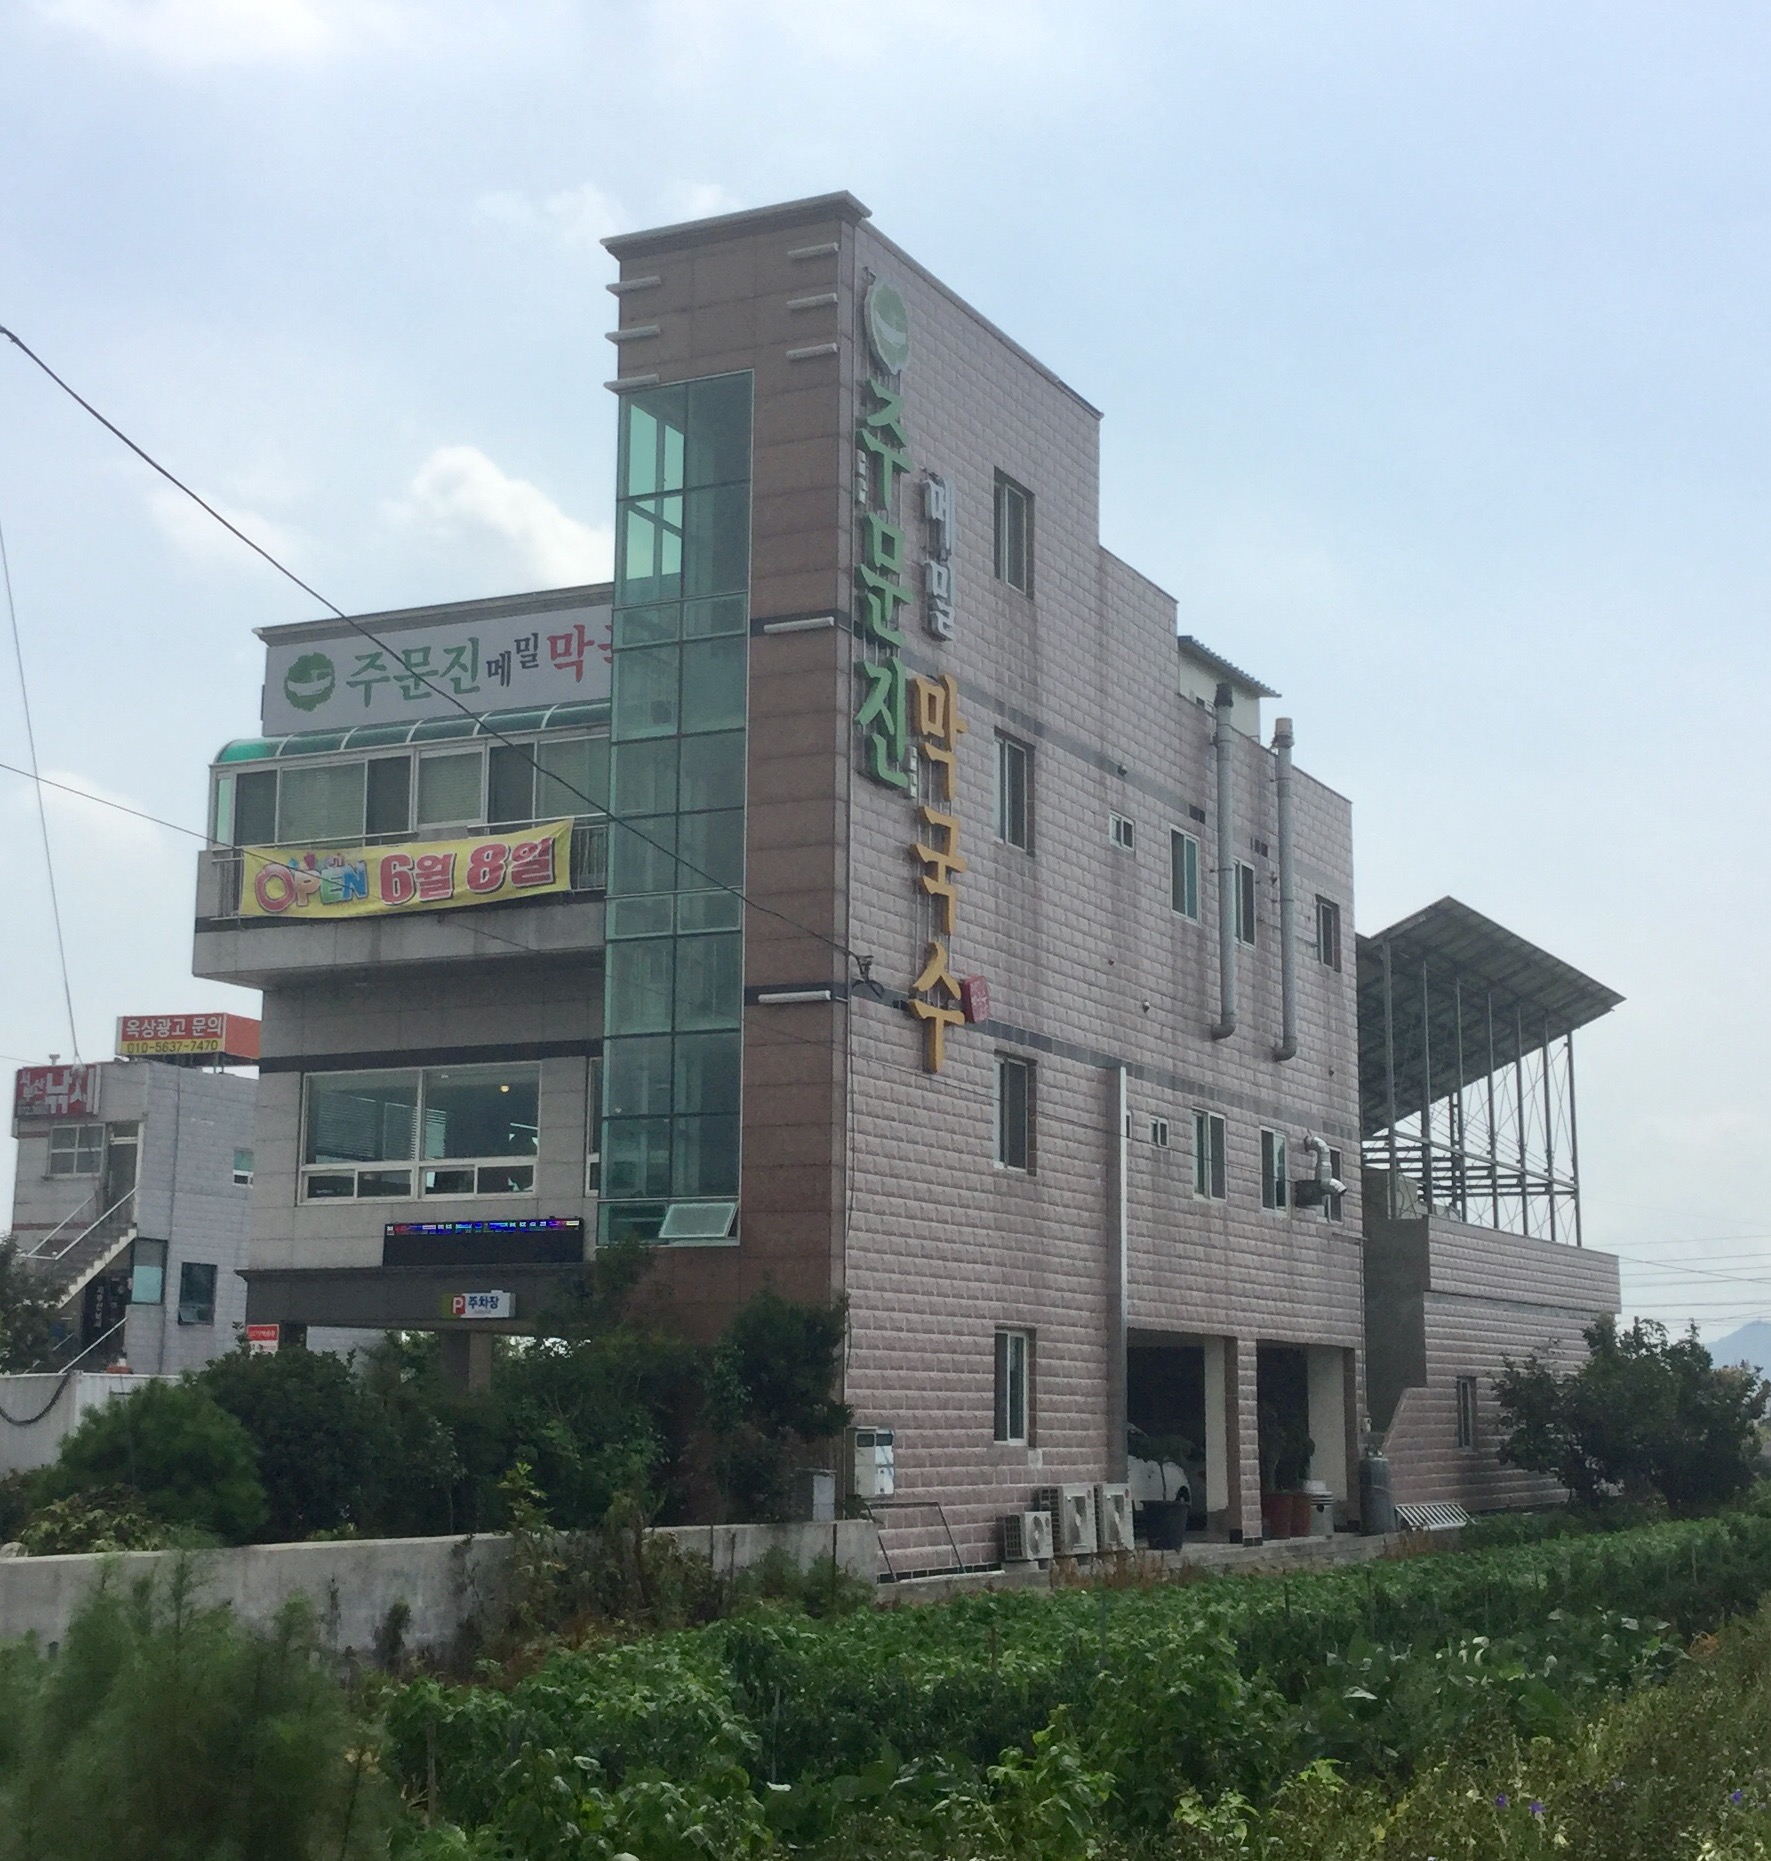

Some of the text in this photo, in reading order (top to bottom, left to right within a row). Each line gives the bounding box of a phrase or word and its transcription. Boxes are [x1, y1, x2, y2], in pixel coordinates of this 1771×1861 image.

[854, 377, 914, 788] 주문진
[346, 624, 613, 708] 주문진 메밀 막
[908, 476, 968, 1074] 메밀 막국수
[254, 836, 556, 914] OPEN 6월 8일
[126, 1015, 222, 1038] 옥상광고 문의
[127, 1039, 219, 1054] 010-5637-7470
[45, 1069, 95, 1114] 낚시
[468, 1296, 500, 1309] 주차장
